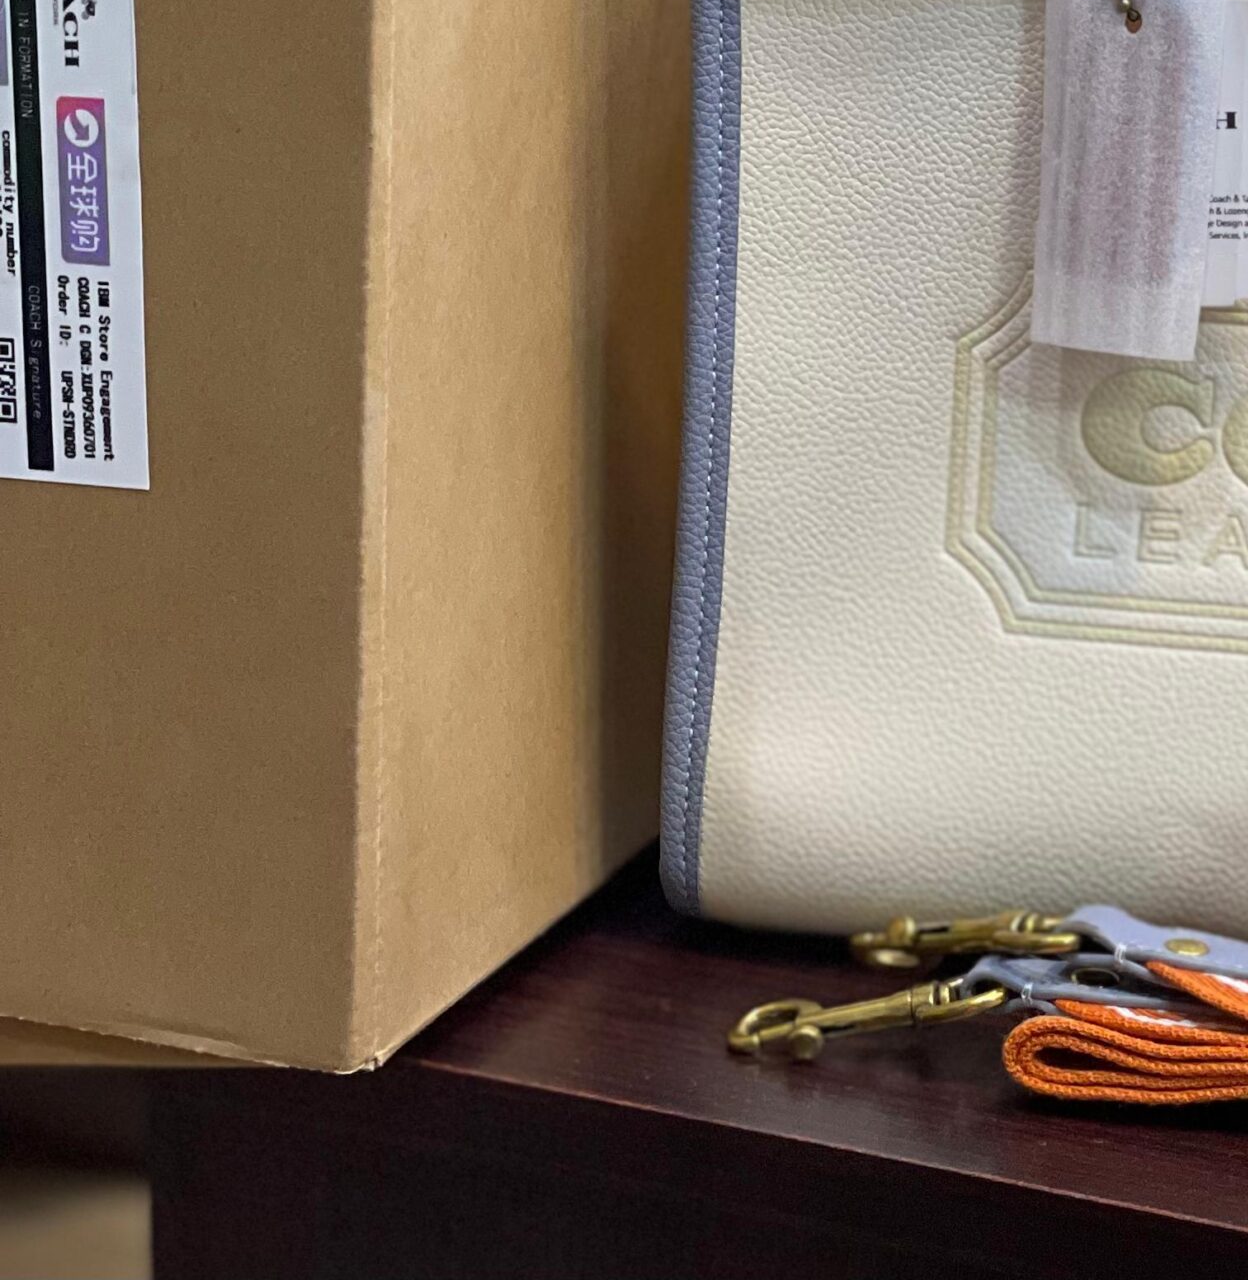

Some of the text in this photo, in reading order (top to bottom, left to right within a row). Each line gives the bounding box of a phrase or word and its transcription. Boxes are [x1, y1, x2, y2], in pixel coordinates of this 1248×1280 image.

[18, 37, 33, 118] FORMATION
[2, 130, 18, 276] commodity number
[67, 152, 100, 254] 全球购
[57, 275, 70, 315] Order
[77, 277, 92, 318] COACH
[79, 324, 92, 334] C
[27, 285, 43, 420] COACH Signature
[98, 314, 112, 362] Store
[99, 370, 115, 462] Engagement
